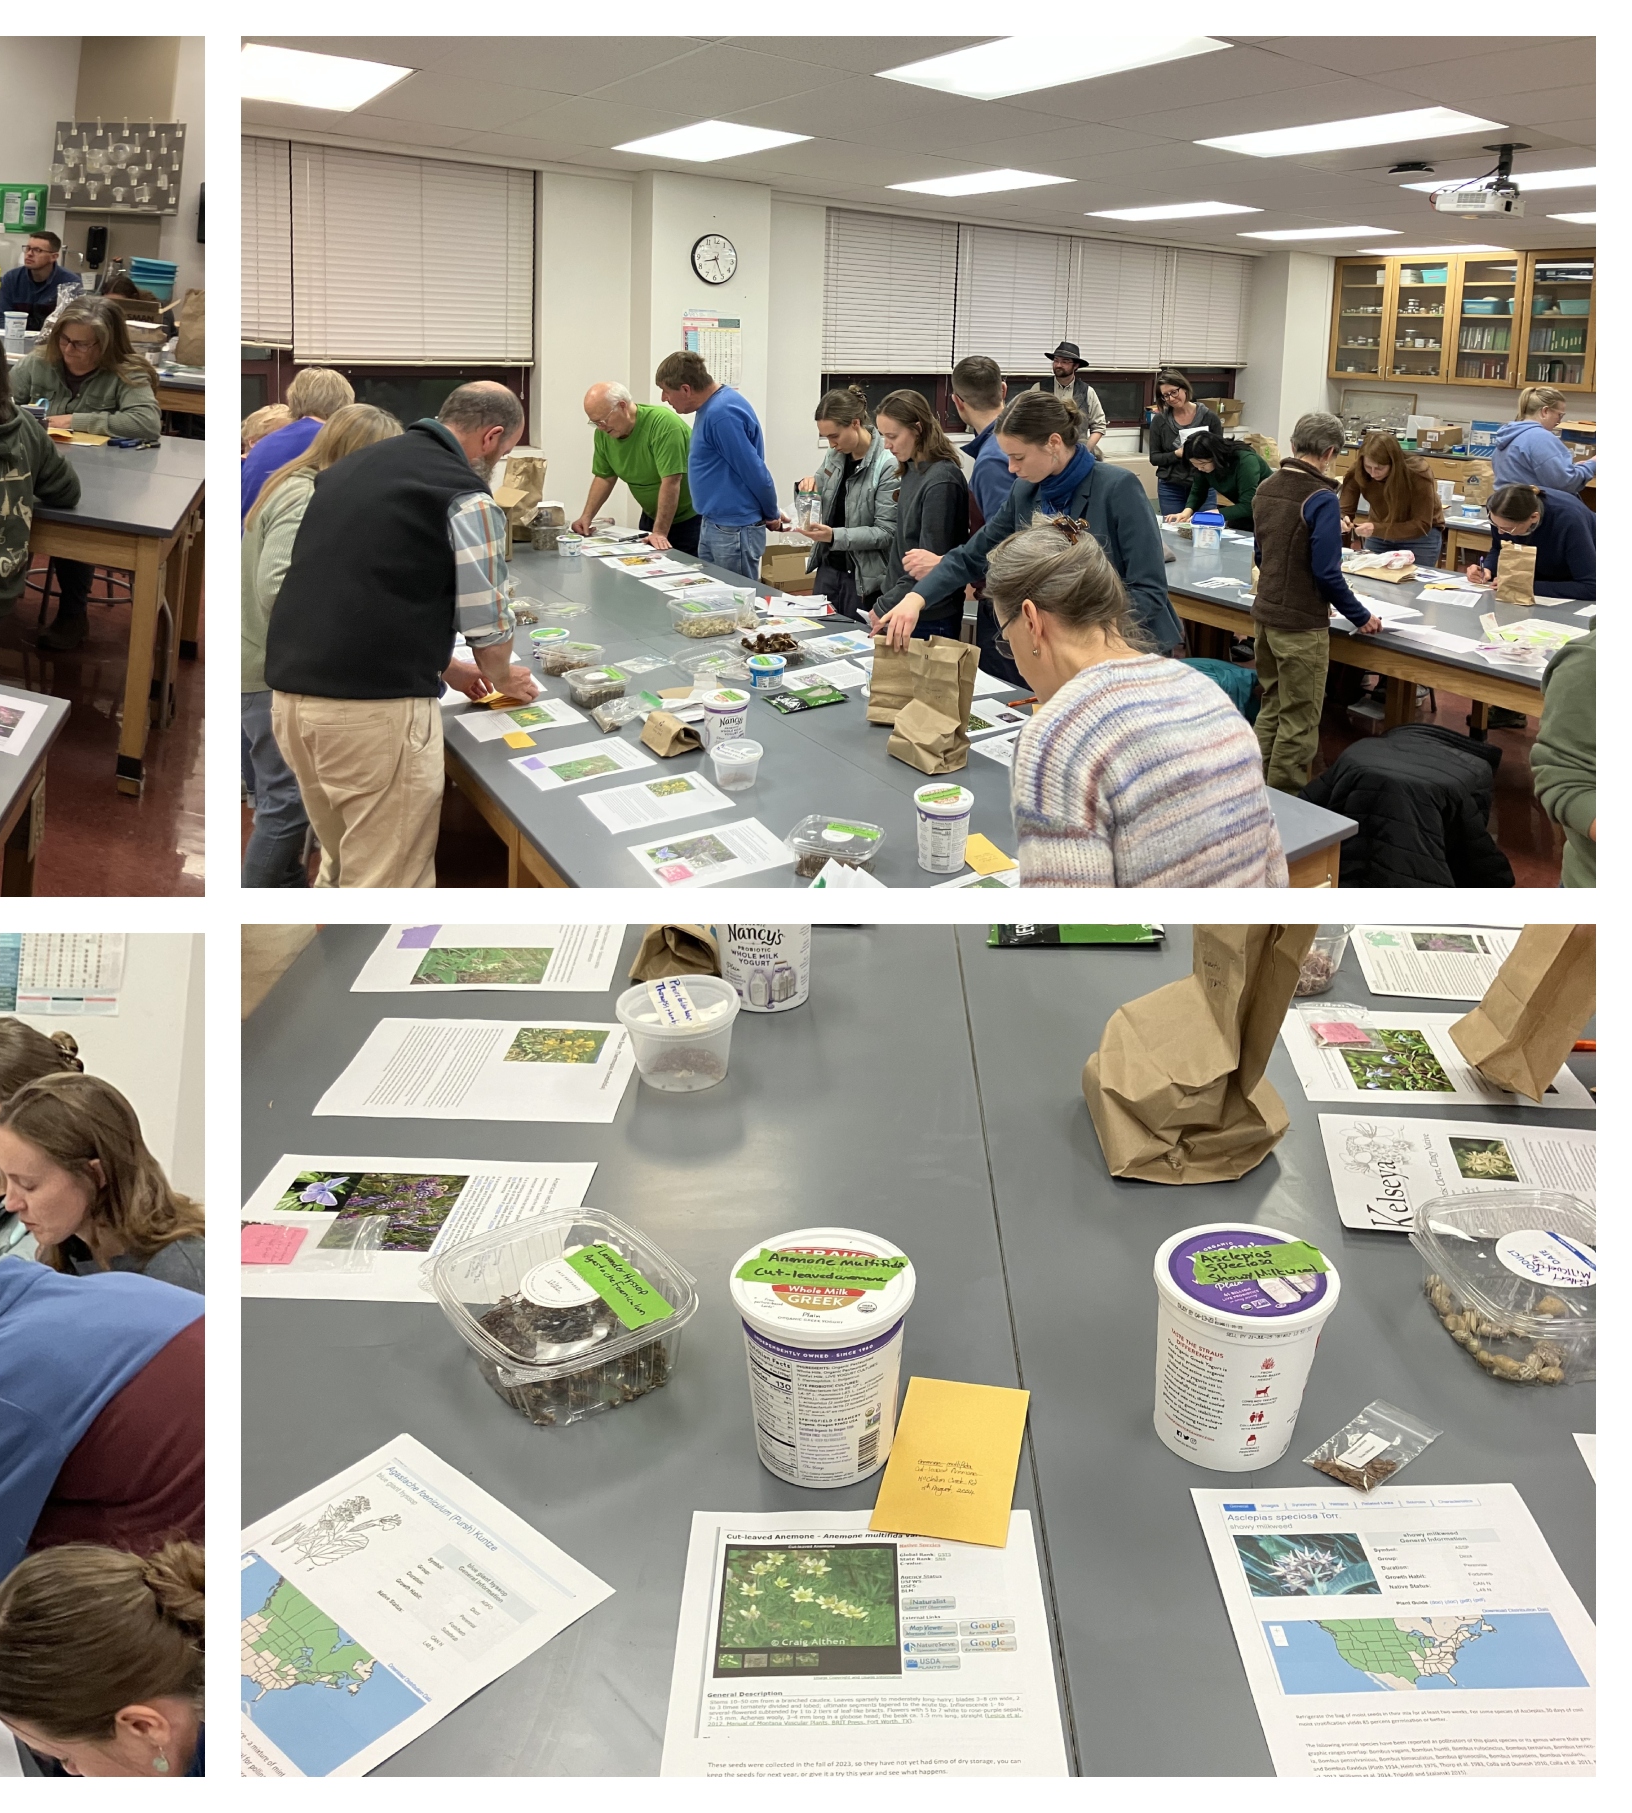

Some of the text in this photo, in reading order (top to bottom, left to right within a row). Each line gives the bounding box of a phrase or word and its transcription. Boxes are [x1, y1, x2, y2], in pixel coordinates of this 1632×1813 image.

[728, 924, 784, 945] Nancy's
[731, 950, 757, 959] WHOLE
[1367, 1160, 1414, 1228] Kelseya
[1203, 1242, 1233, 1251] ORGANIC
[1200, 1251, 1272, 1263] Asclepias
[1539, 1249, 1560, 1264] DATE
[789, 1286, 822, 1294] Whole
[788, 1295, 843, 1306] GREEK
[754, 1335, 800, 1357] INDEPENDENTLY
[836, 1350, 856, 1358] SINCE
[1171, 1328, 1224, 1359] TASTE THE STRAUS
[1176, 1340, 1213, 1362] DIFFERENCE
[775, 1381, 791, 1390] 130
[834, 1414, 861, 1422] CREAMERY
[376, 1472, 418, 1505] blue giant hyssop
[387, 1466, 498, 1551] Agastache foeniculum (Pursh) Kuntze
[459, 1566, 504, 1603] General Information
[467, 1563, 508, 1597] blue giant hyssop
[970, 1620, 1005, 1631] Google
[782, 1637, 845, 1647] Craig Althen
[970, 1638, 1005, 1648] Google
